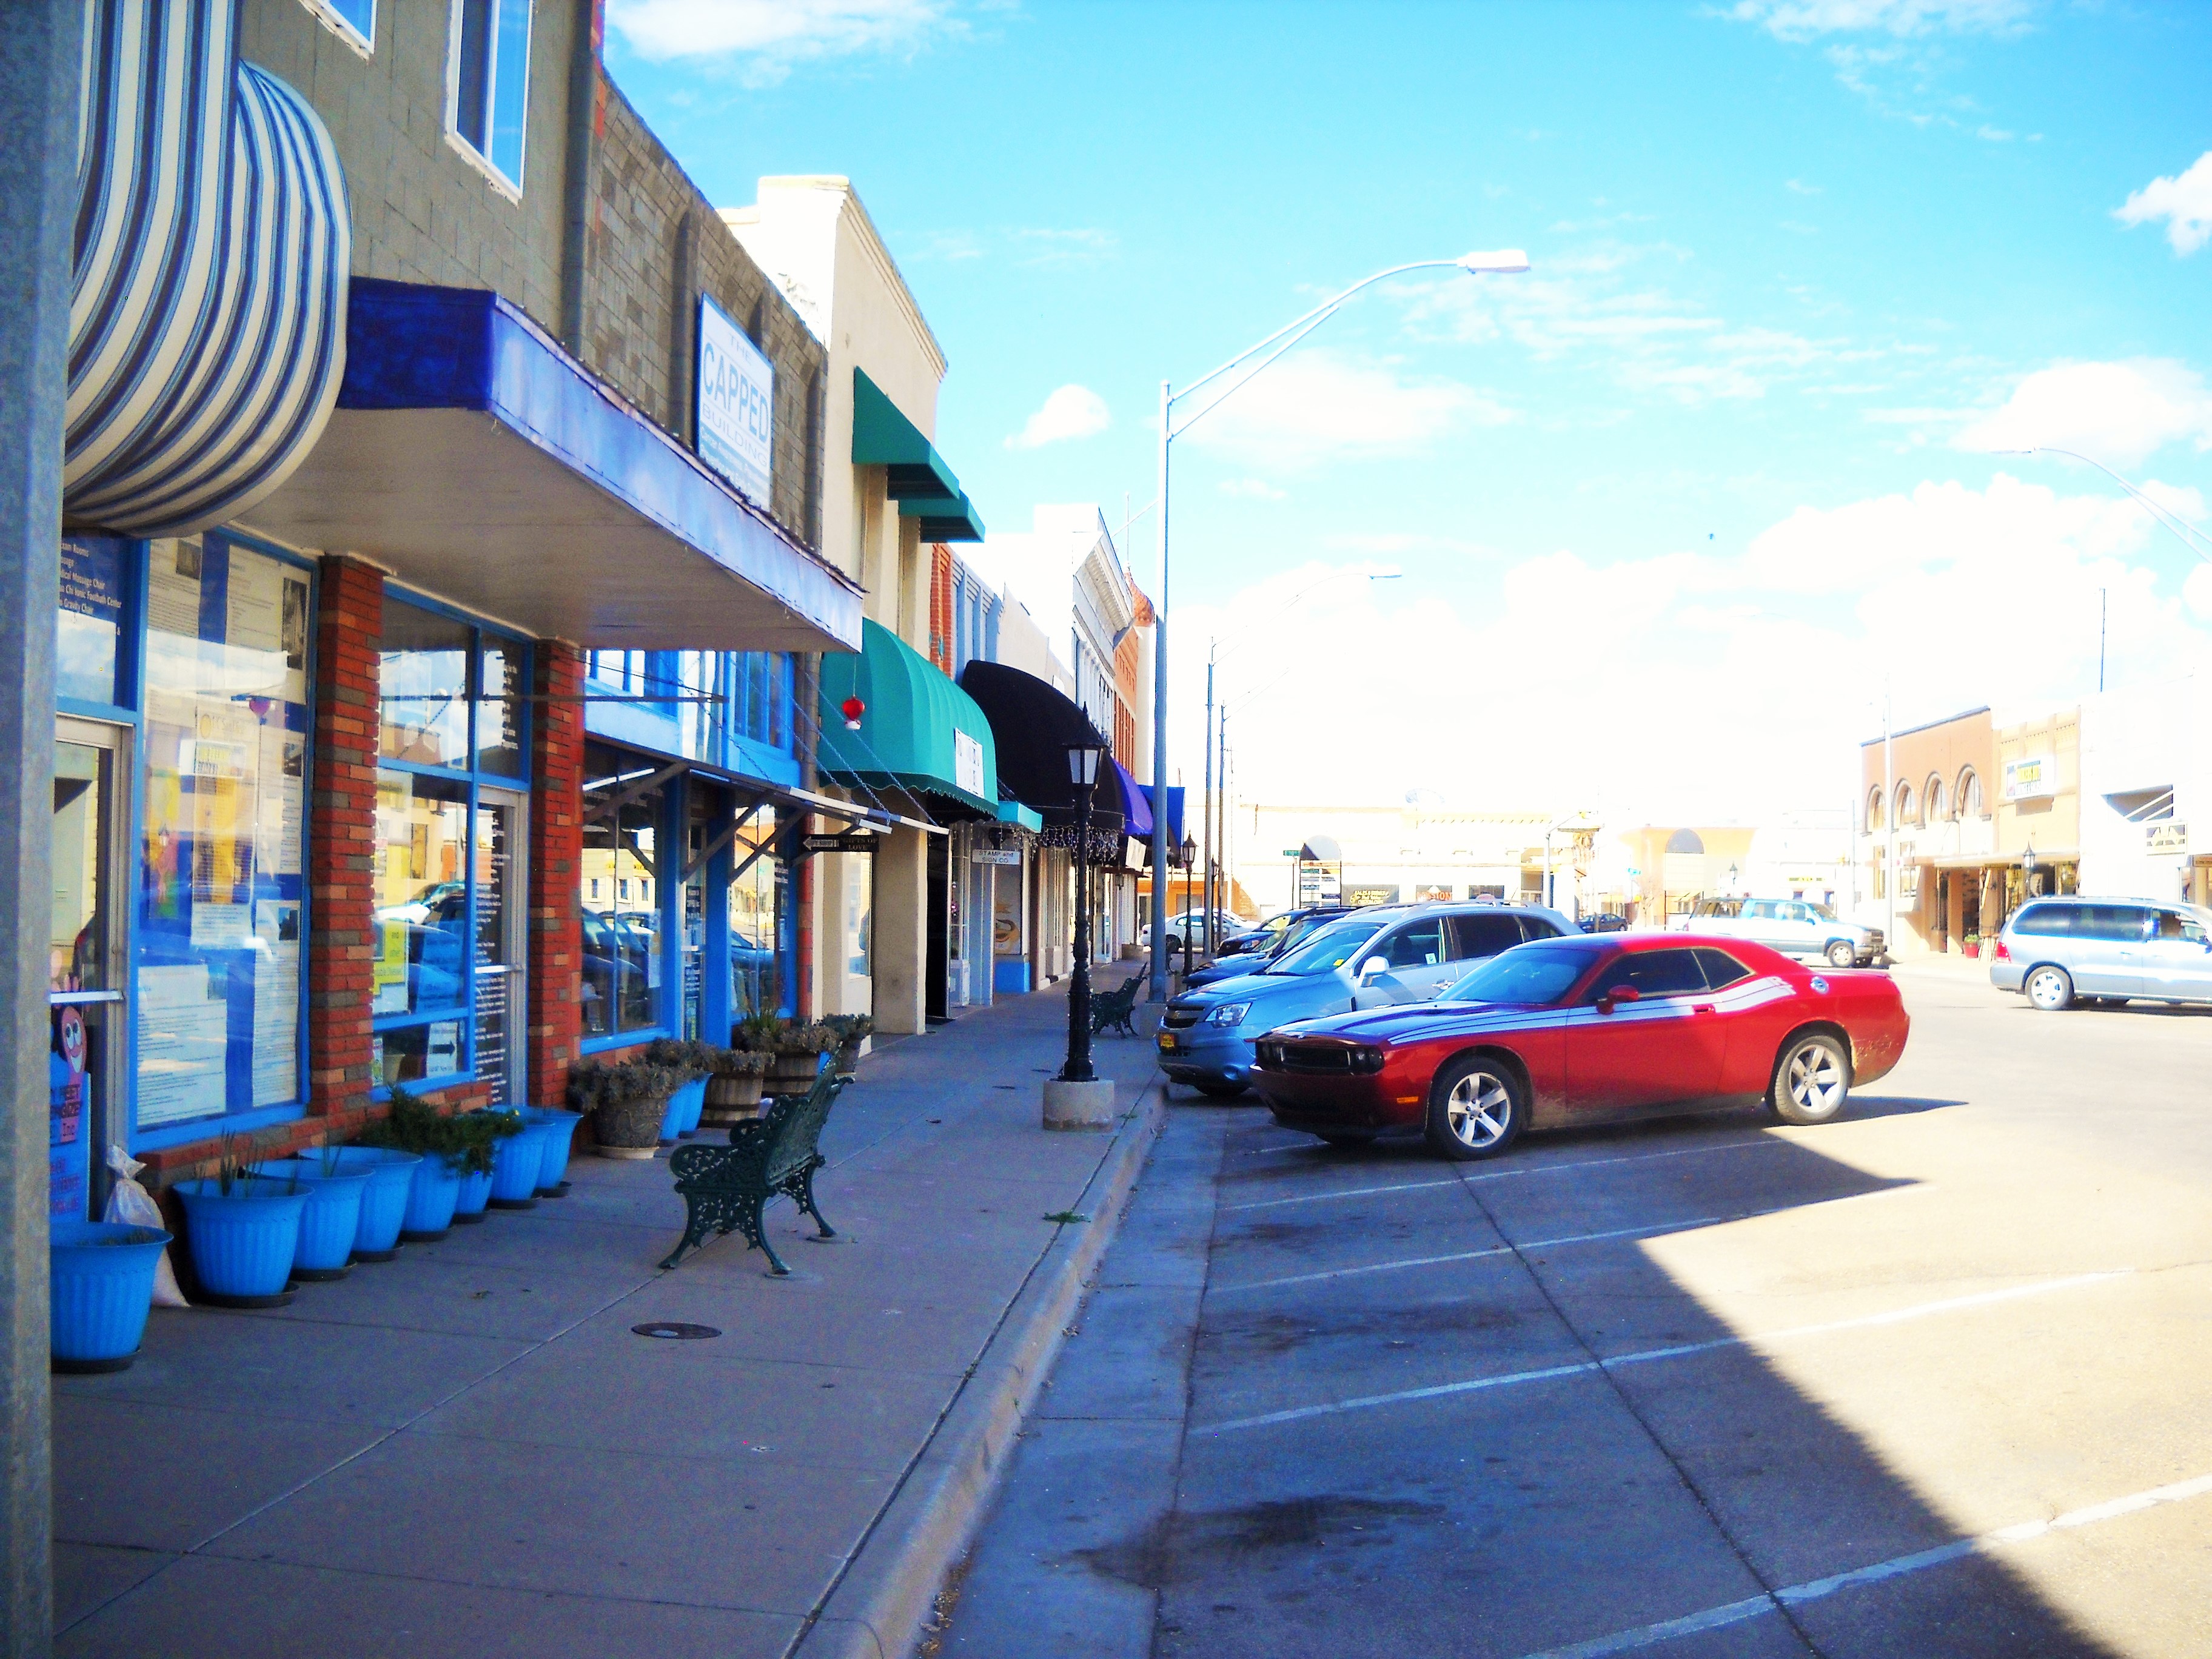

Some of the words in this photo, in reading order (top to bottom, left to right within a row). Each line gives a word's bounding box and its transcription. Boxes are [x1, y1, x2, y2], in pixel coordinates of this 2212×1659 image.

[729, 335, 752, 363] THE
[703, 341, 769, 443] CAPPED
[702, 403, 767, 467] BUILDING
